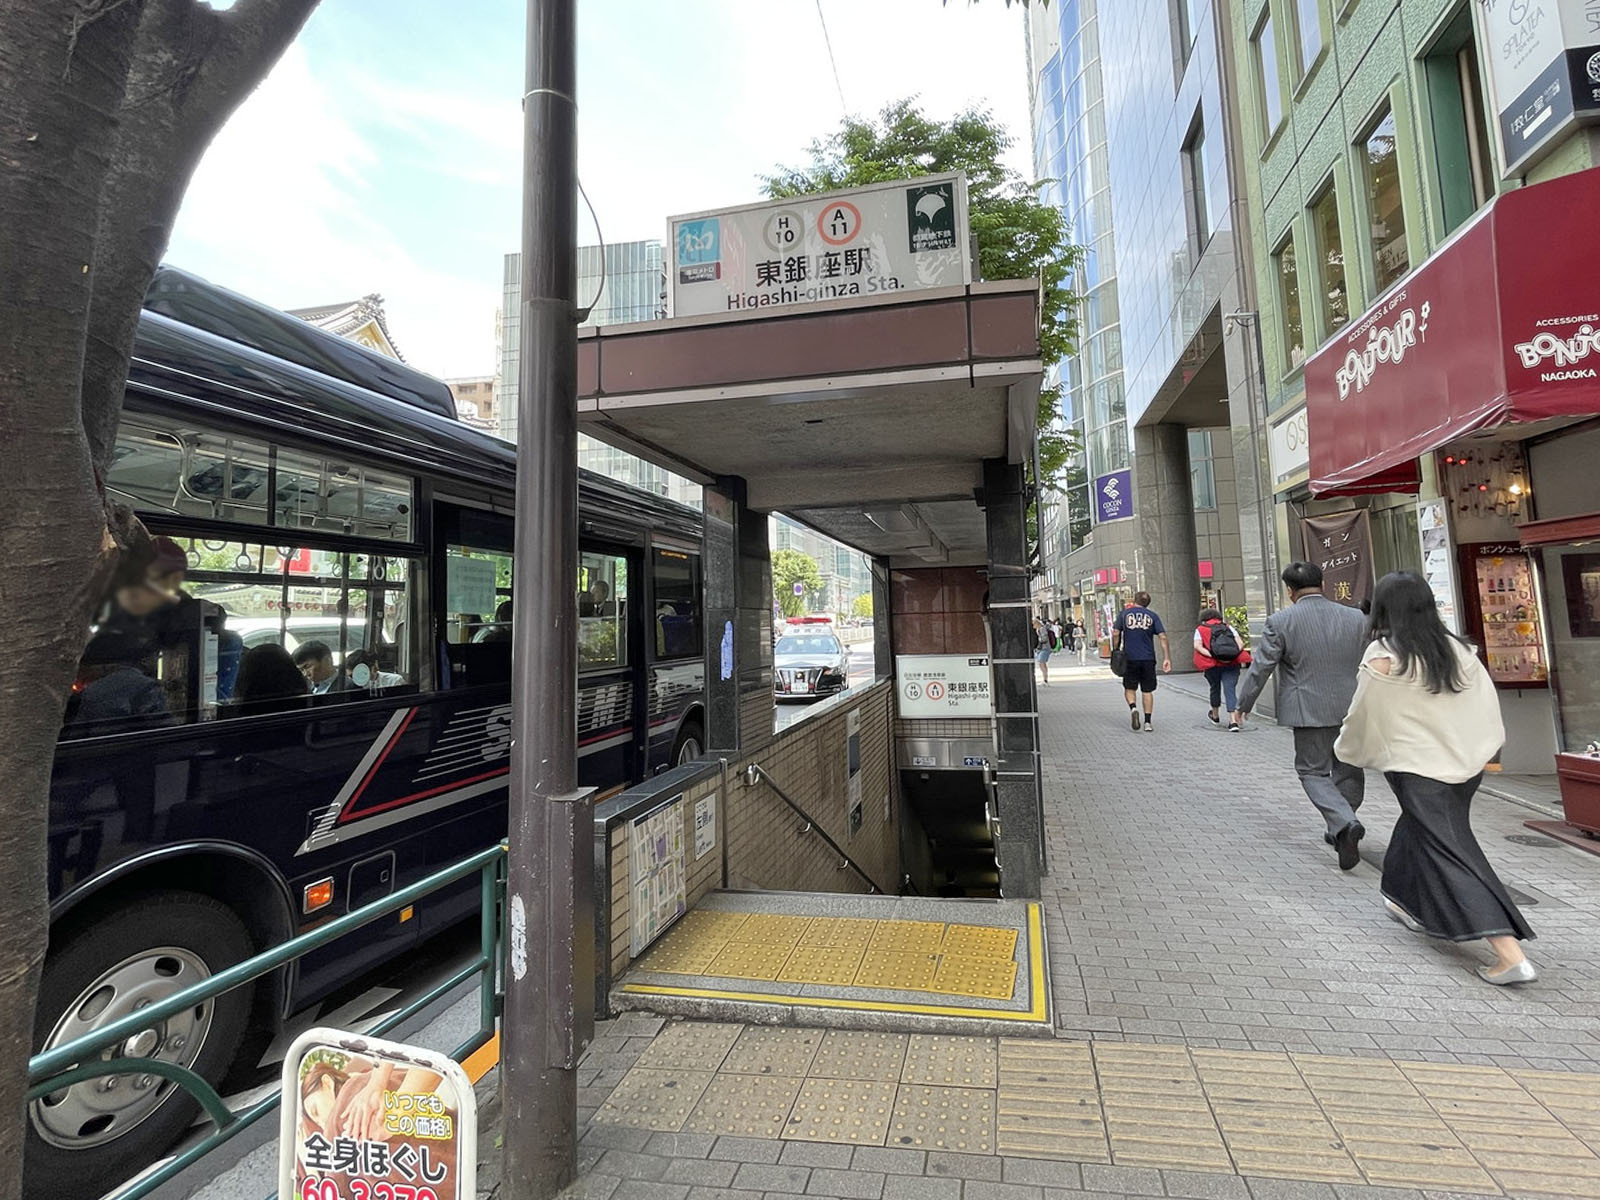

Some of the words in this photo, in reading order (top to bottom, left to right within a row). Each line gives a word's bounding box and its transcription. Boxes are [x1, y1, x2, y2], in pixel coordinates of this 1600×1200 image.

[778, 217, 789, 229] H
[833, 209, 845, 221] A
[775, 230, 794, 243] 10
[830, 222, 848, 236] 11
[756, 247, 873, 287] 東銀座駅
[727, 283, 860, 310] Higashi-ginza
[867, 276, 905, 293] Sta.
[1535, 314, 1599, 327] ACCESSORIES
[1335, 308, 1417, 401] BONJOUR
[1541, 368, 1597, 382] NAGAOKA
[1321, 552, 1358, 571] ダイエット
[384, 1092, 443, 1113] いつでも
[385, 1114, 453, 1137] この価格!
[304, 1133, 446, 1182] 全身ほぐし
